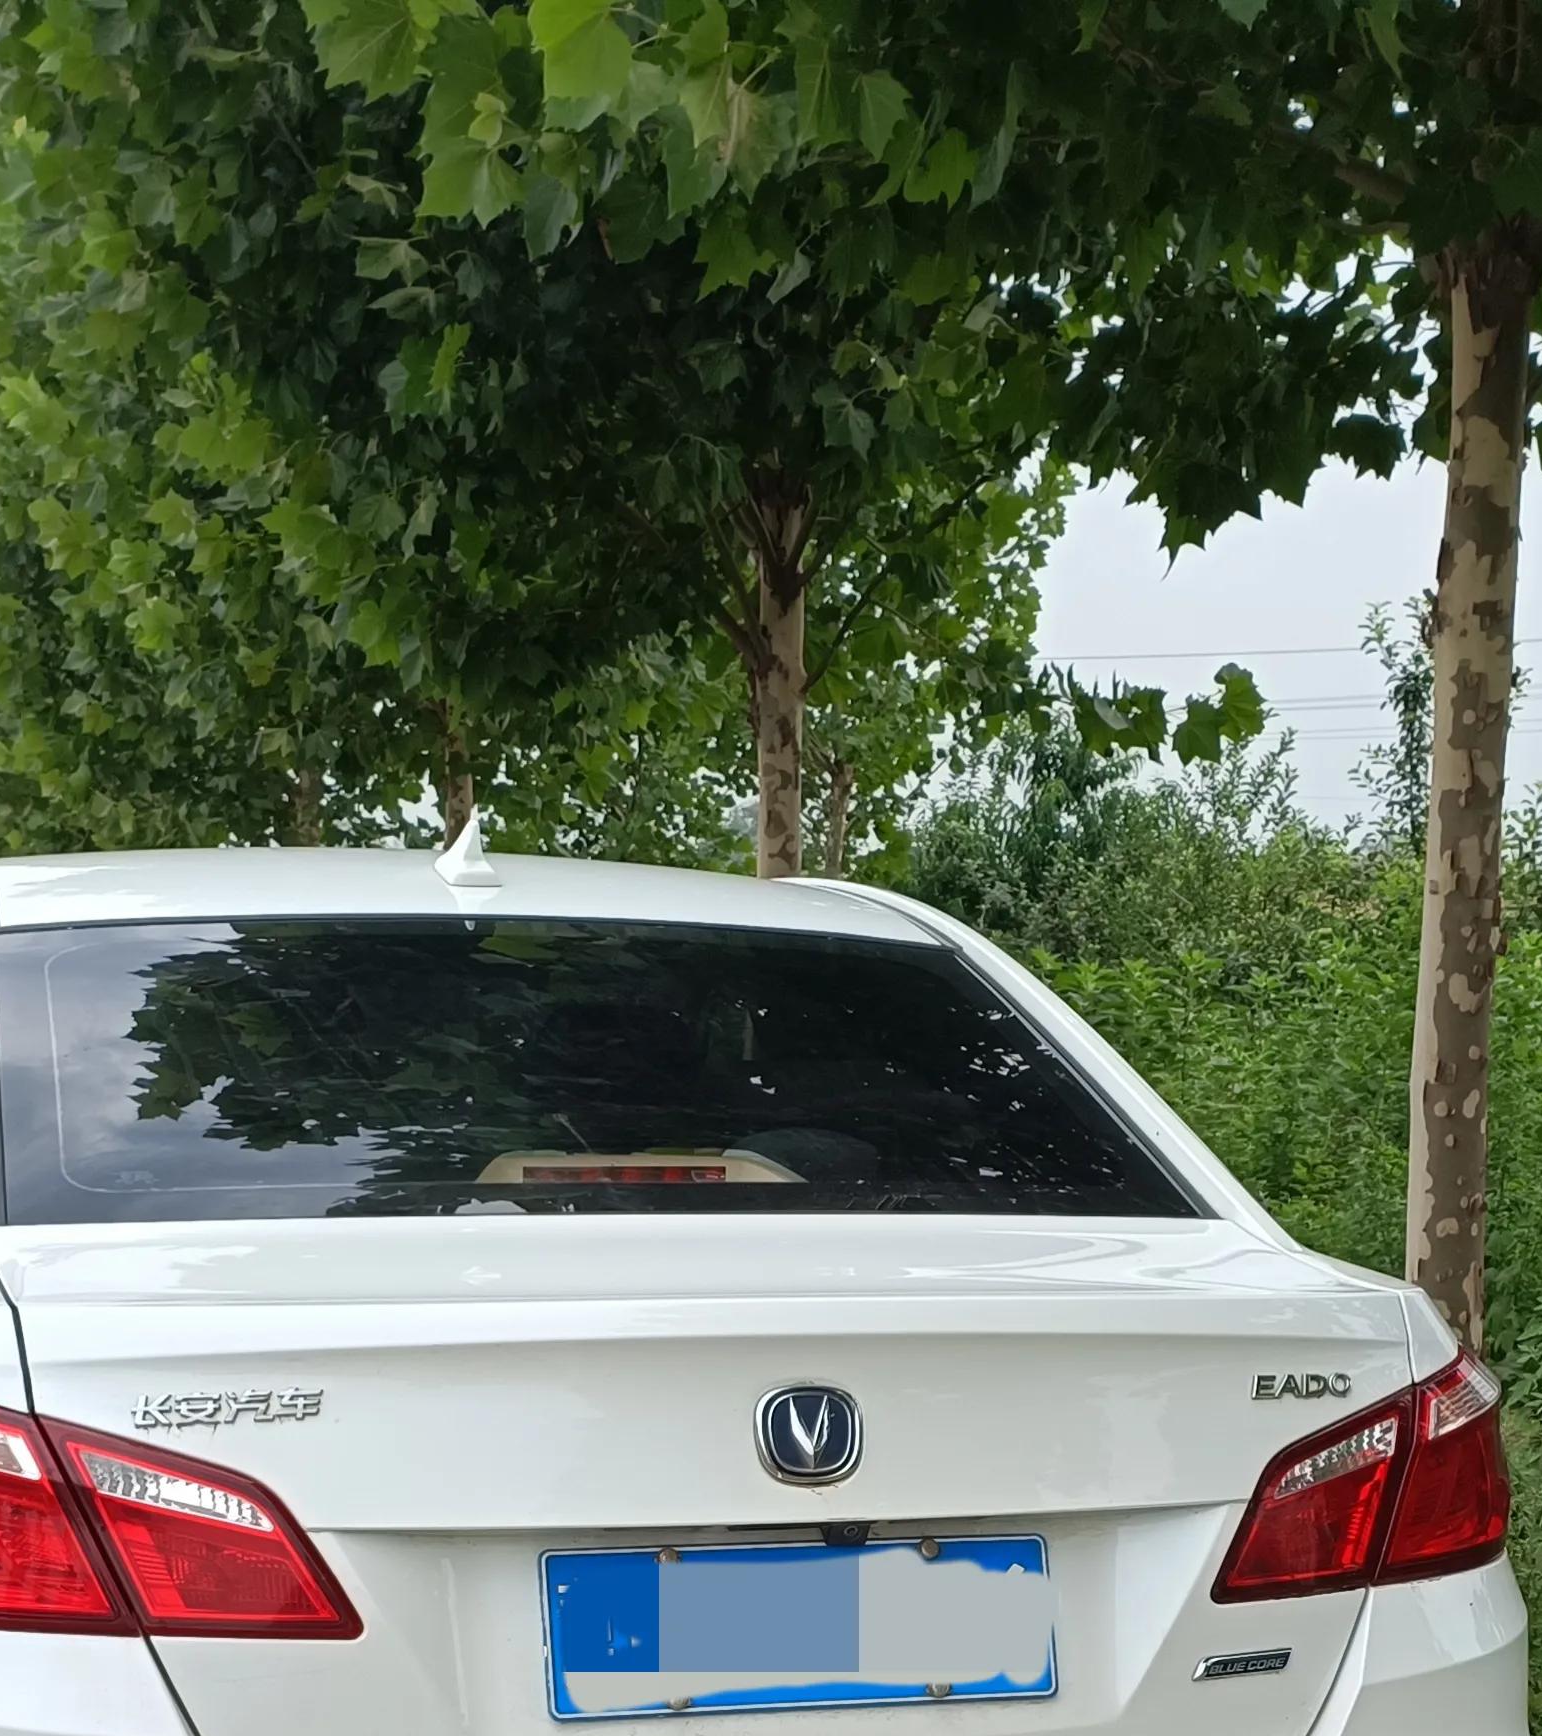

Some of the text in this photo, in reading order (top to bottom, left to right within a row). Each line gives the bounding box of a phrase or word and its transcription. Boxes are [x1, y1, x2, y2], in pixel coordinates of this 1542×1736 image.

[1251, 1372, 1351, 1400] EADO
[131, 1386, 324, 1428] 长安汽车
